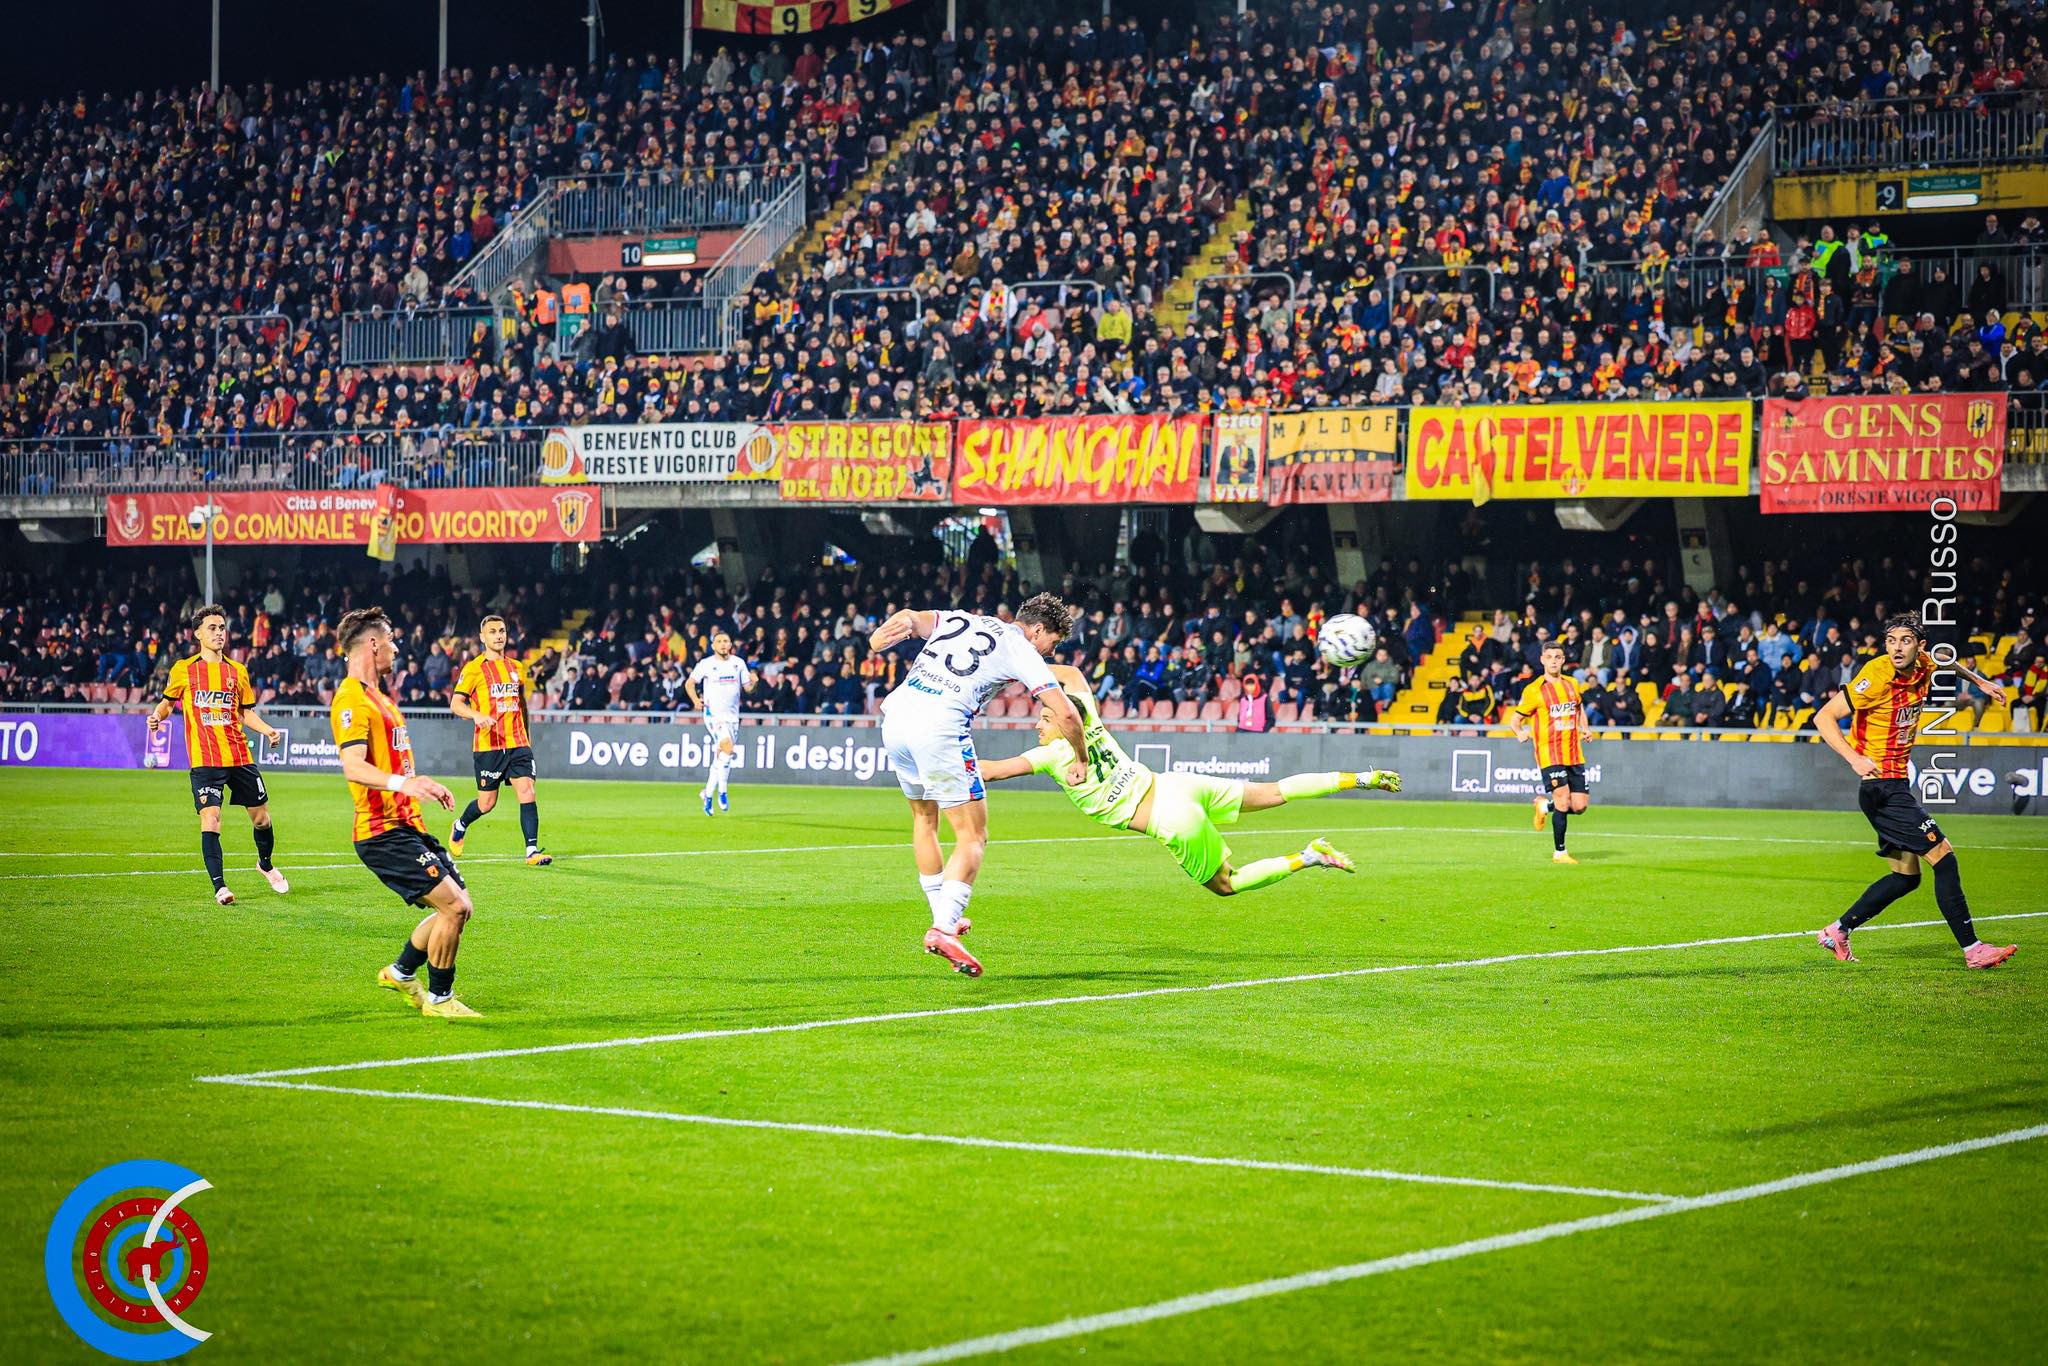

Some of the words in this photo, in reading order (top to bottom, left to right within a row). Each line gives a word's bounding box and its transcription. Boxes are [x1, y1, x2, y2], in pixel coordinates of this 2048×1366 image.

[1883, 186, 1896, 205] 9
[622, 246, 641, 264] 10
[1272, 415, 1395, 439] MALDOF
[1823, 402, 1942, 439] GENS
[583, 430, 685, 450] BENEVENTO
[691, 430, 737, 448] CLUB
[787, 422, 947, 460] STREGONI
[584, 456, 648, 475] ORESTE
[654, 454, 736, 474] VIGORITO
[958, 423, 1198, 494] SHANGHAI
[1765, 446, 1996, 485] SAMNITES
[783, 480, 821, 498] DEL
[1216, 485, 1259, 500] VIVE
[1821, 491, 1889, 506] ORESTE
[286, 494, 318, 511] Città
[320, 496, 333, 509] di
[336, 496, 404, 510] Benevo
[151, 512, 230, 541] STADO
[234, 512, 356, 540] COMUNALE
[922, 616, 997, 677] 23
[195, 691, 234, 705] IVPC
[0, 721, 39, 762] TO
[568, 730, 649, 768] Dove
[755, 734, 776, 769] il
[1173, 756, 1270, 775] arredamenti
